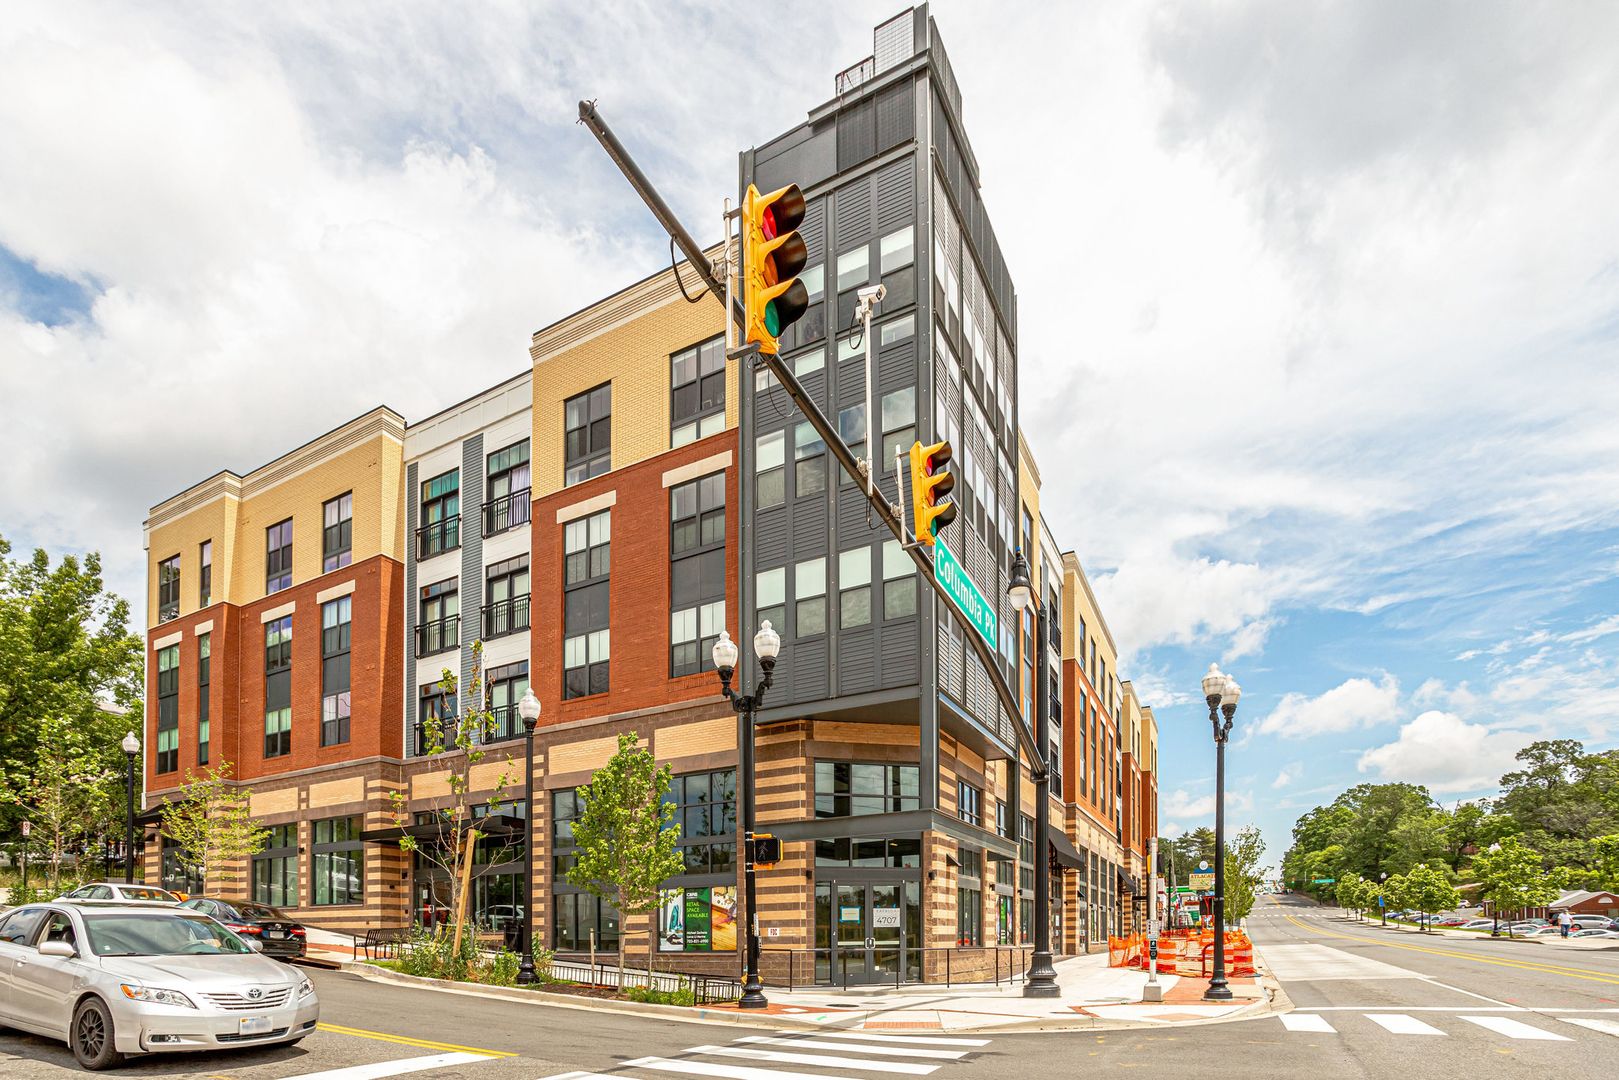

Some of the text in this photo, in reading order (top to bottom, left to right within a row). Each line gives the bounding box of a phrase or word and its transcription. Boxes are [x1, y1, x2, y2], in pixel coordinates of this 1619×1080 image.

[937, 549, 995, 640] Columbia Pk
[876, 916, 897, 924] 4707
